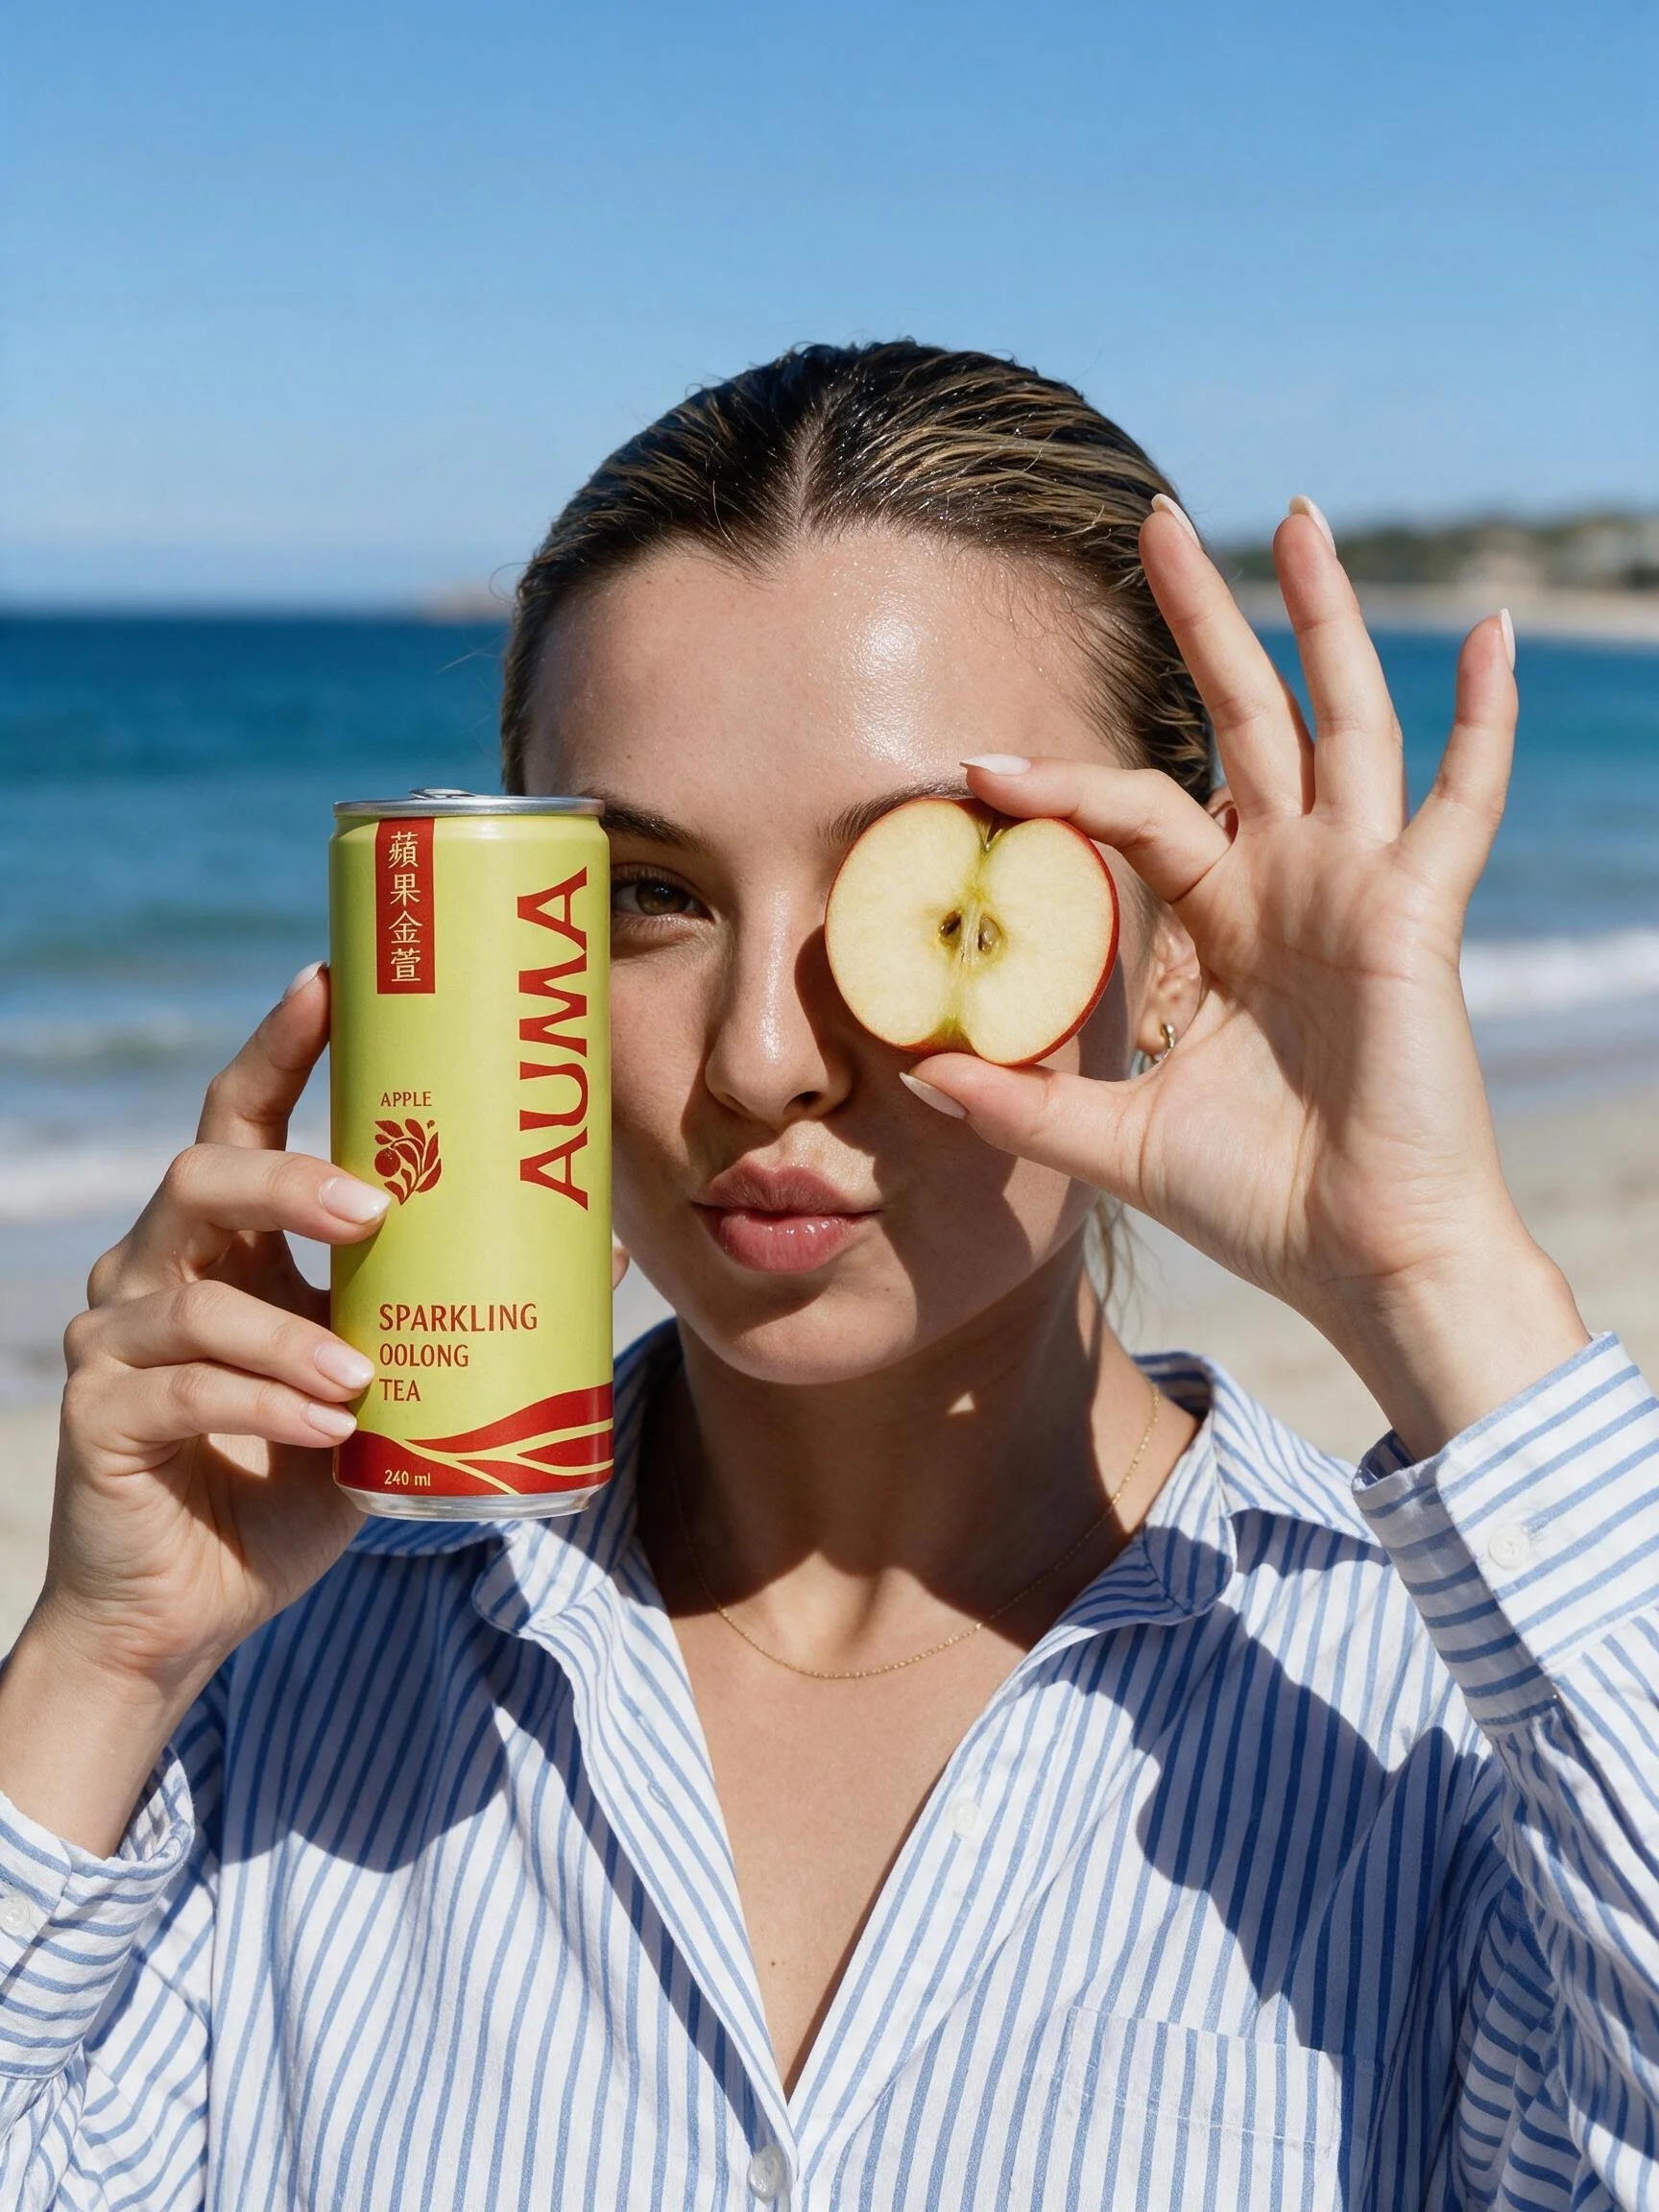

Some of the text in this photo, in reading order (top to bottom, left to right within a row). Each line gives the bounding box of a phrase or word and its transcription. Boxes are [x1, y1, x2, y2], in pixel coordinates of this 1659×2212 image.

[516, 865, 589, 1211] AUMA
[380, 1091, 433, 1107] APPLE
[379, 1303, 538, 1332] SPARKLING
[379, 1343, 469, 1367] OOLONG
[379, 1378, 421, 1403] TEA
[384, 1469, 431, 1487] 240 ml
